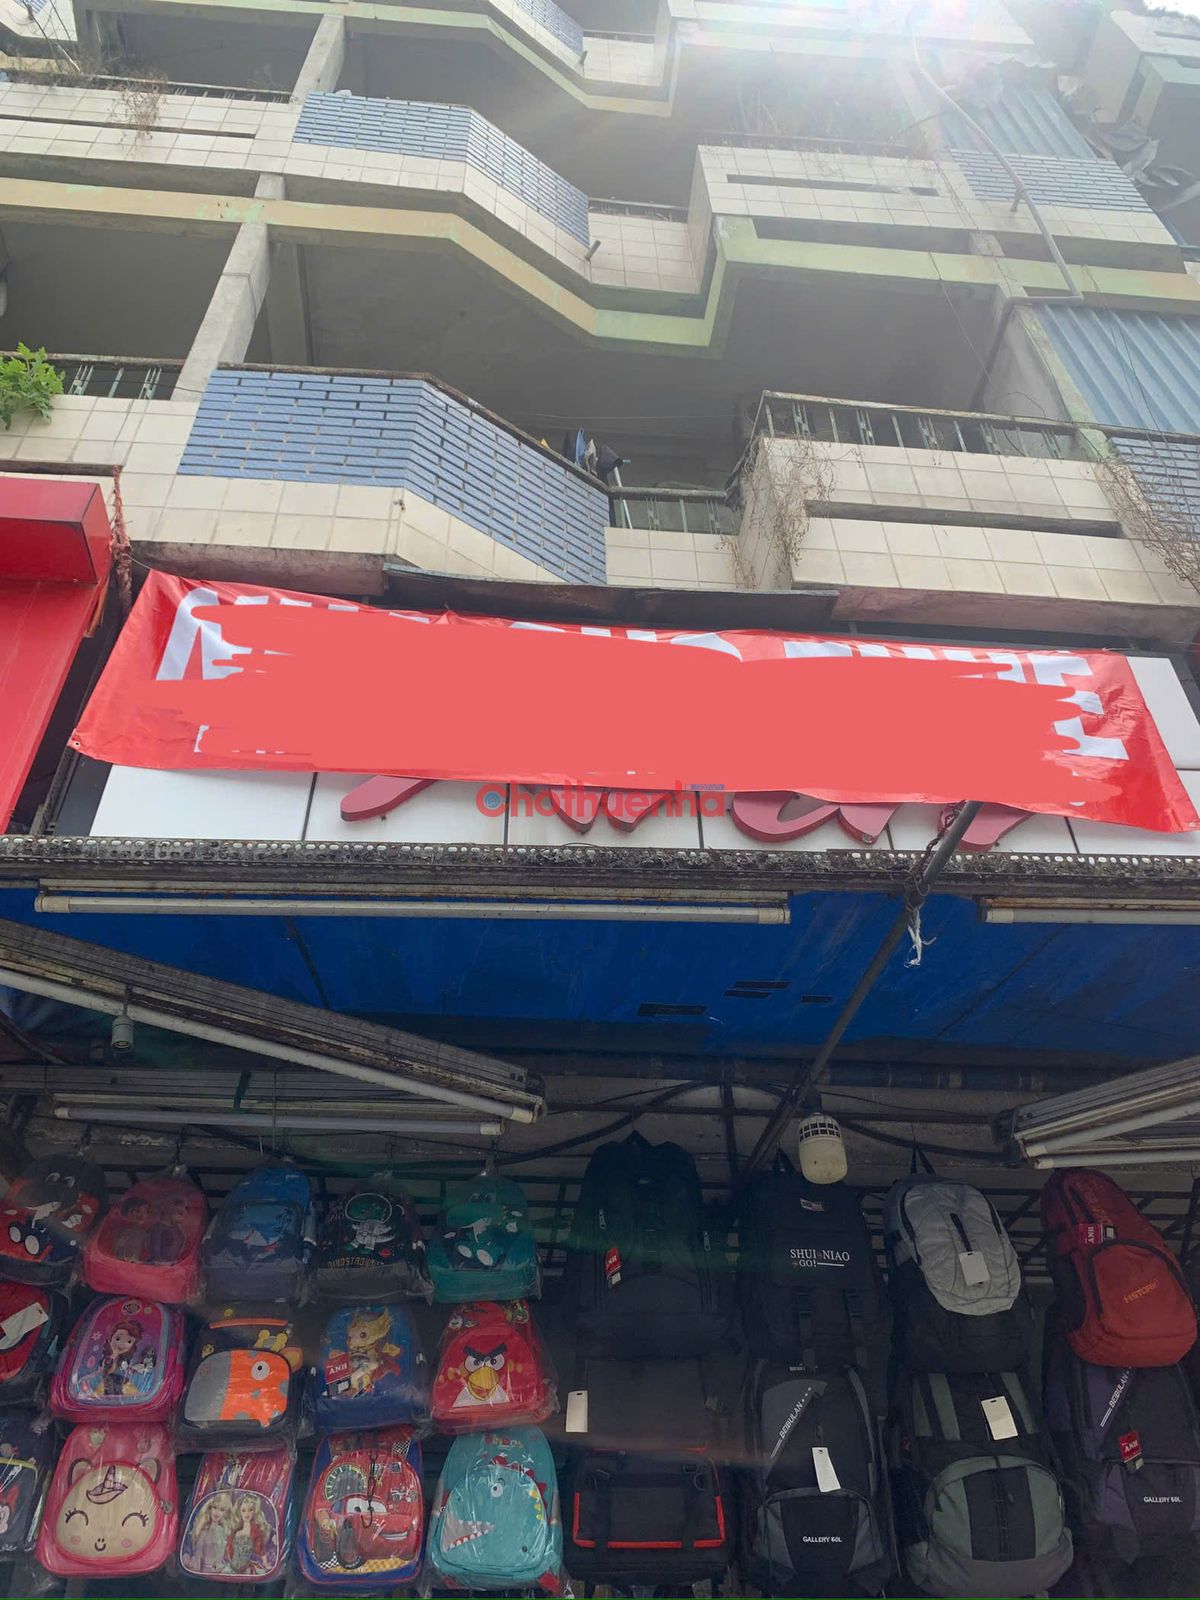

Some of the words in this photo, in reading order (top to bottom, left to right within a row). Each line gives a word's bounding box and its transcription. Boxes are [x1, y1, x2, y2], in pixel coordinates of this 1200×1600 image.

[790, 1248, 817, 1259] SHUI
[822, 1249, 850, 1262] NIAO
[779, 1401, 803, 1439] BEIBULAN
